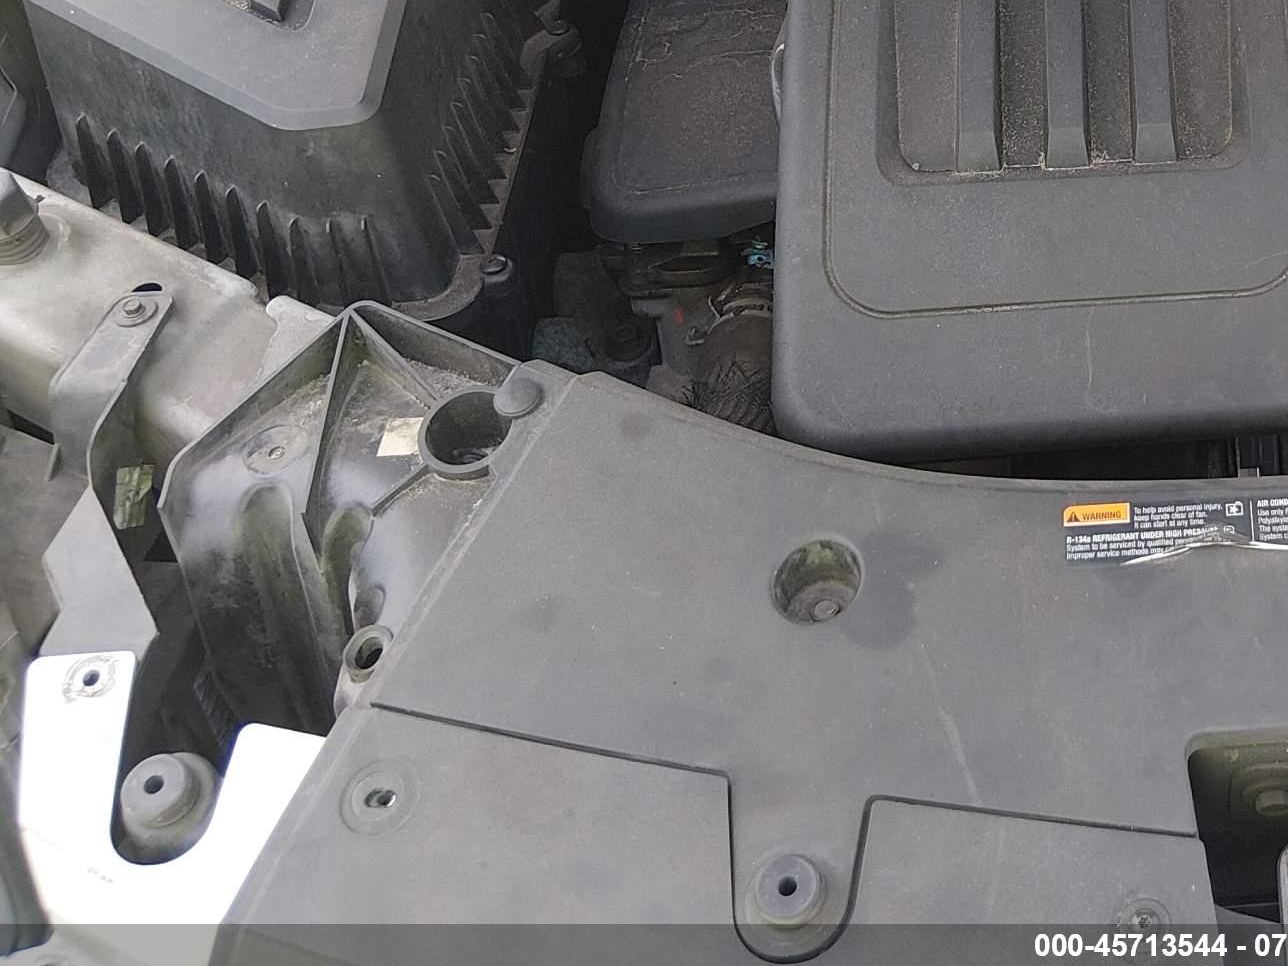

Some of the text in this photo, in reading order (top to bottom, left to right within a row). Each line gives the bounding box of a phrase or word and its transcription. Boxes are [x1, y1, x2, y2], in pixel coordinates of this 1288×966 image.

[1257, 499, 1269, 507] AIR
[1082, 512, 1122, 522] WARNING
[1066, 535, 1091, 543] R-134a
[1092, 532, 1140, 542] REFRIGERANT
[1141, 530, 1164, 539] UNDER
[1165, 529, 1182, 538] HIGH
